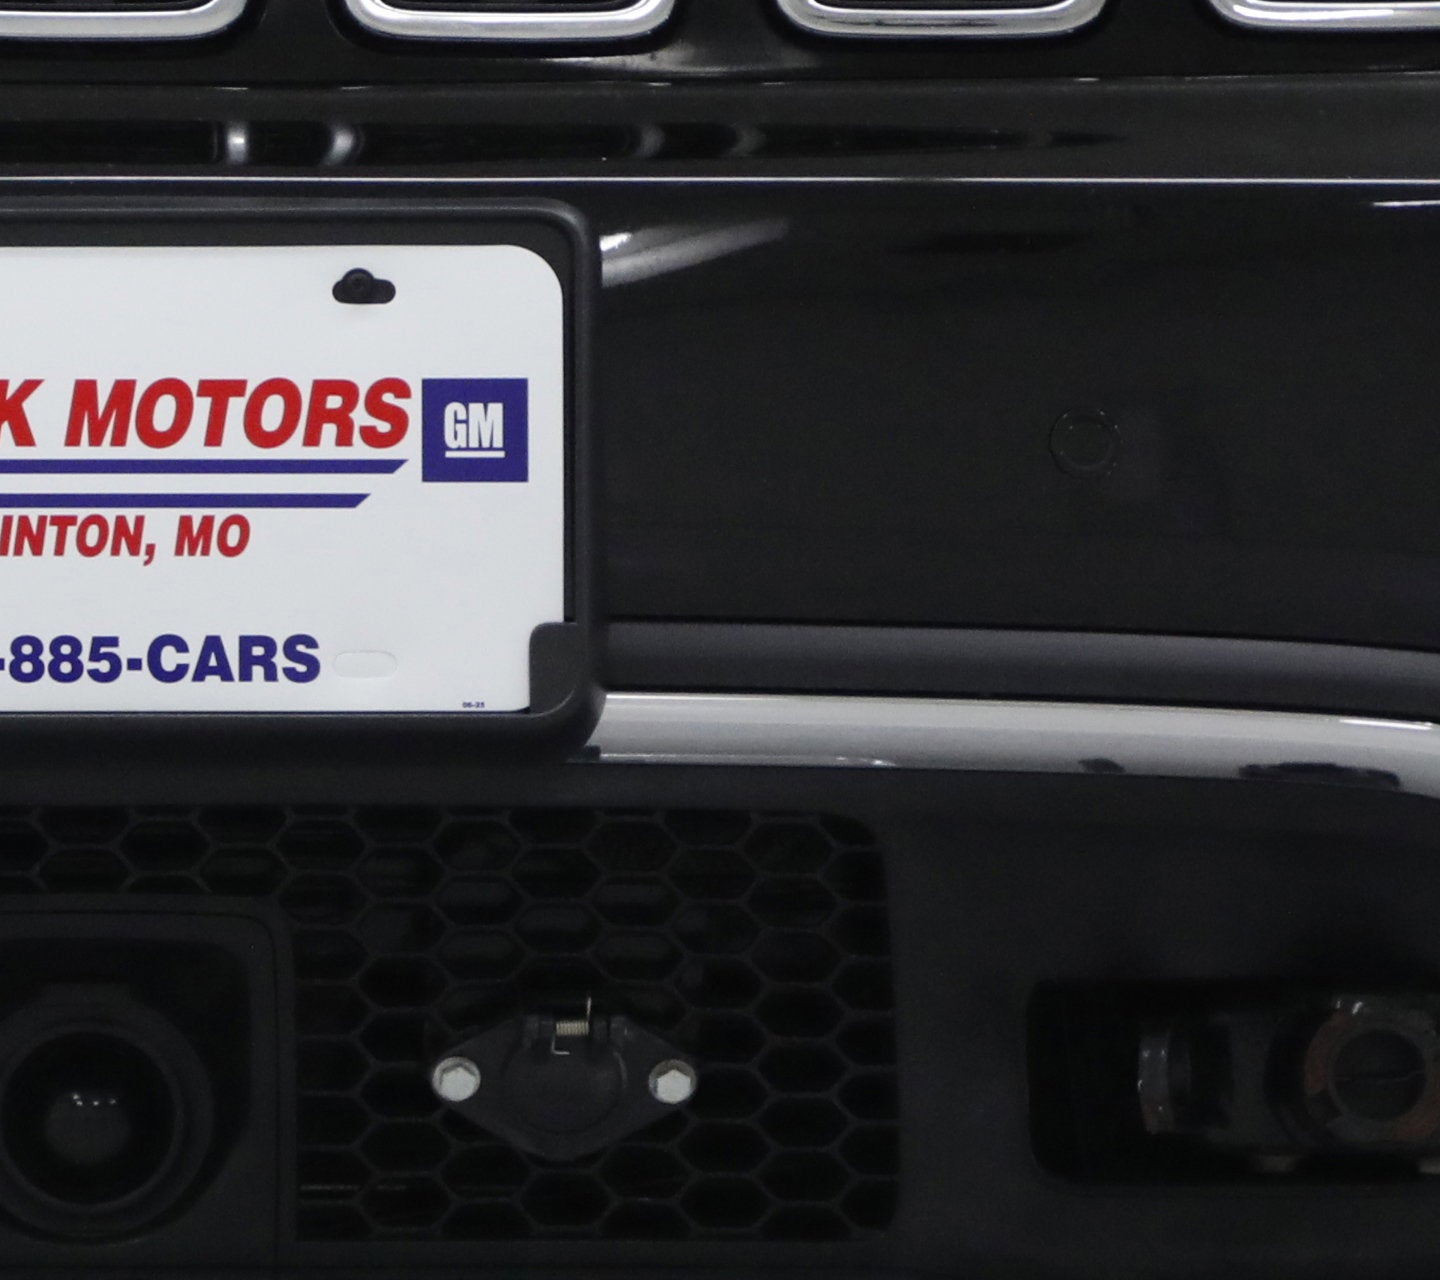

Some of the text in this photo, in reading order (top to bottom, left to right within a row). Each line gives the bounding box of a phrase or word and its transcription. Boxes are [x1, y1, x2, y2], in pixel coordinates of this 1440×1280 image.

[64, 377, 413, 451] MOTORS
[443, 403, 505, 451] GM
[173, 514, 252, 559] MO
